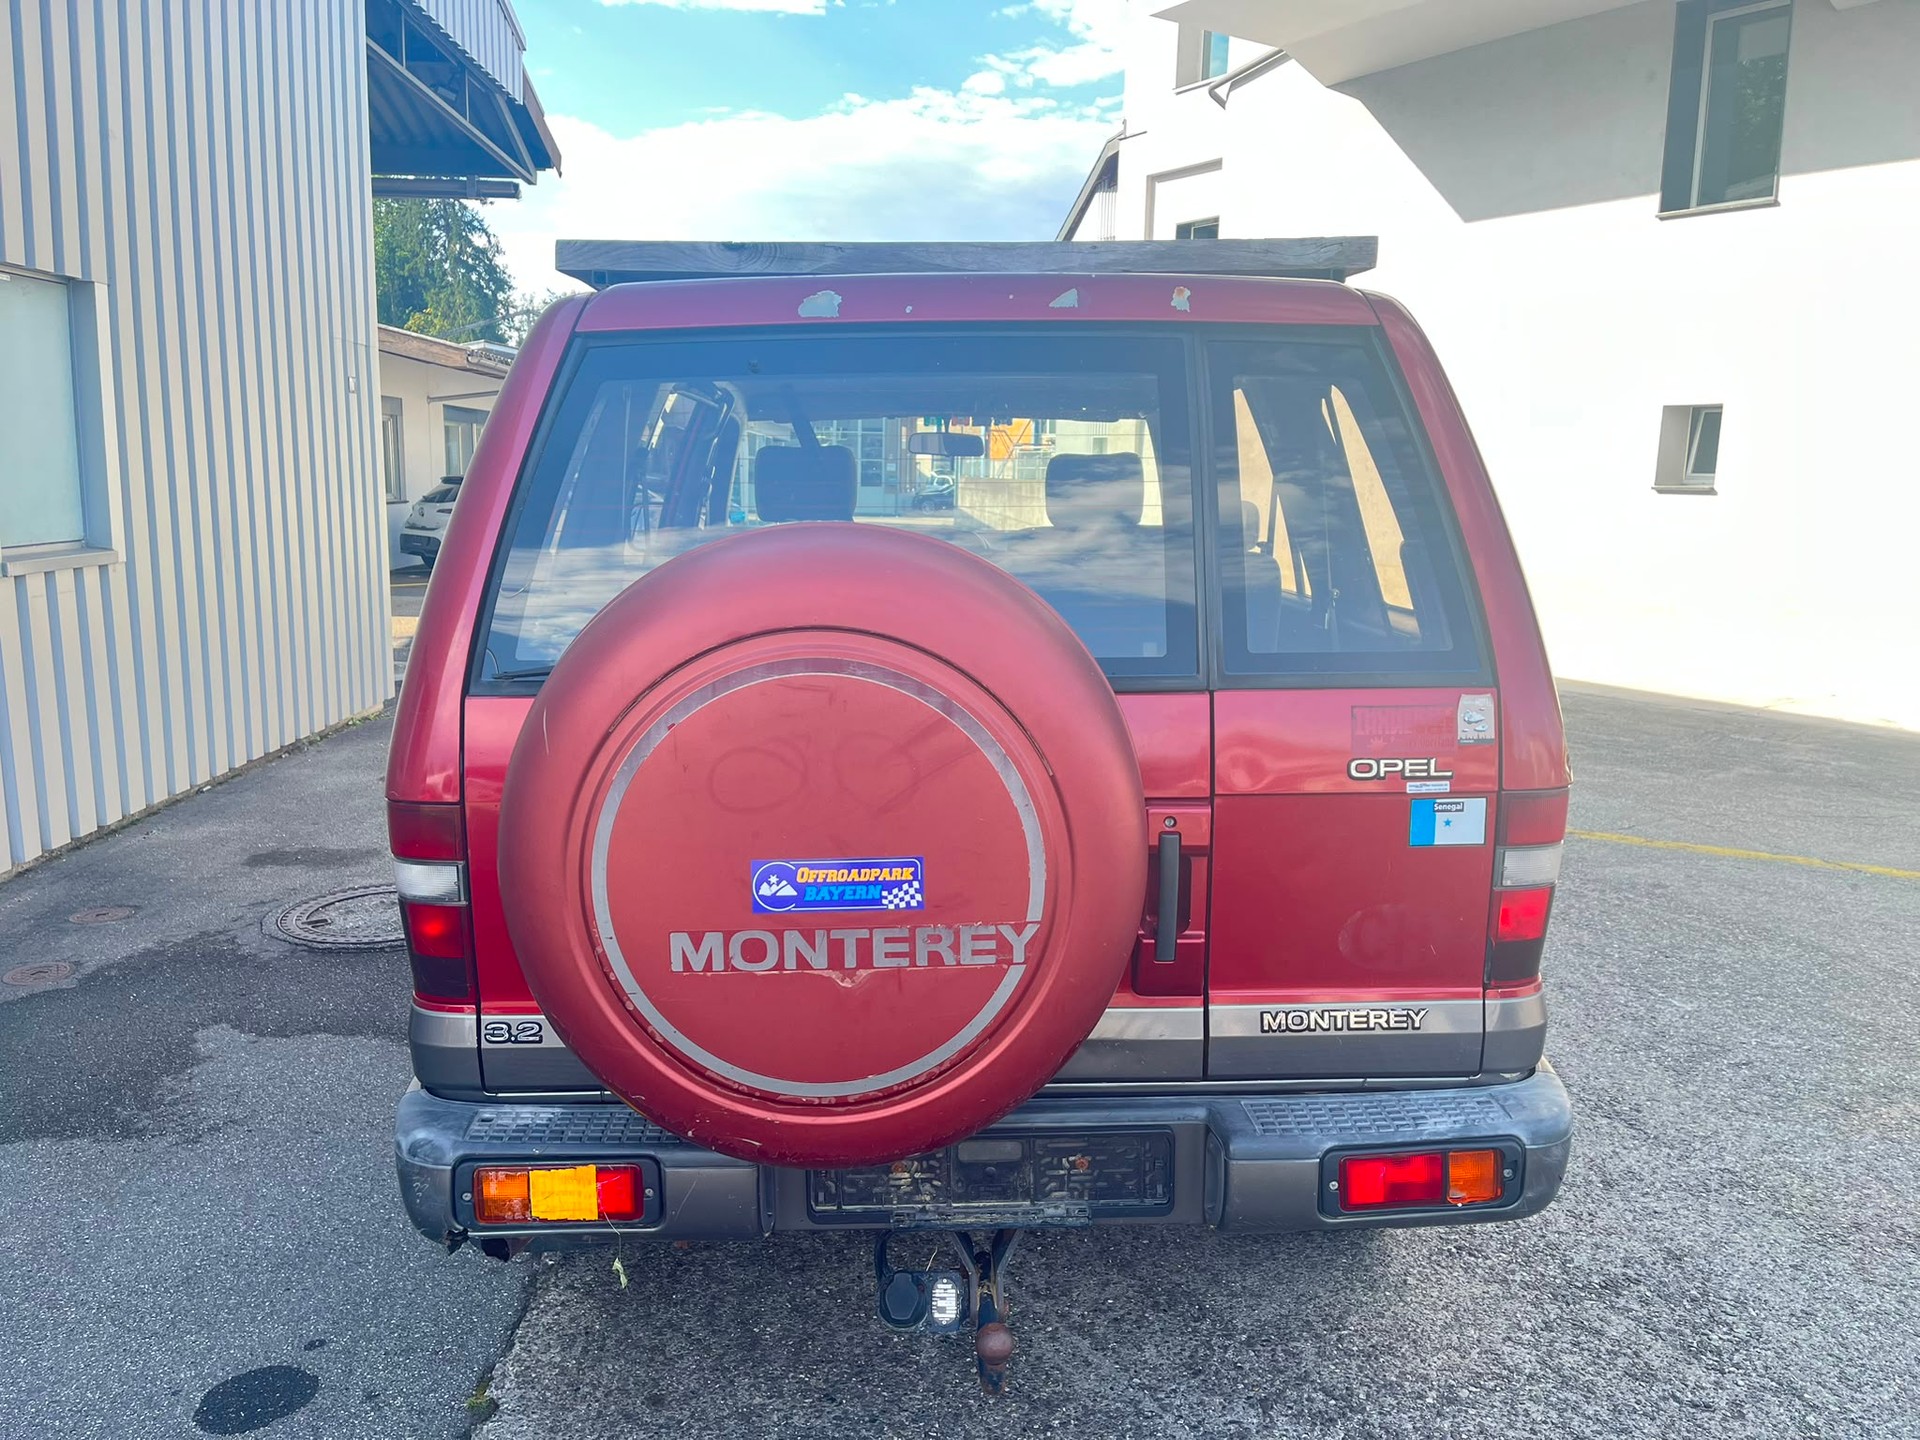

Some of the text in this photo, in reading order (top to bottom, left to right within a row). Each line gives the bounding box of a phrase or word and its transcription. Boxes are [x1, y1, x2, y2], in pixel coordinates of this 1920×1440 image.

[1349, 757, 1453, 779] OPEL
[1433, 802, 1463, 812] Senegal
[796, 866, 914, 883] OFFROADPARK
[803, 885, 882, 902] BAYERN
[669, 923, 1040, 972] MONTEREY
[1260, 1008, 1429, 1033] MONTEREY
[484, 1022, 543, 1044] 3.2
